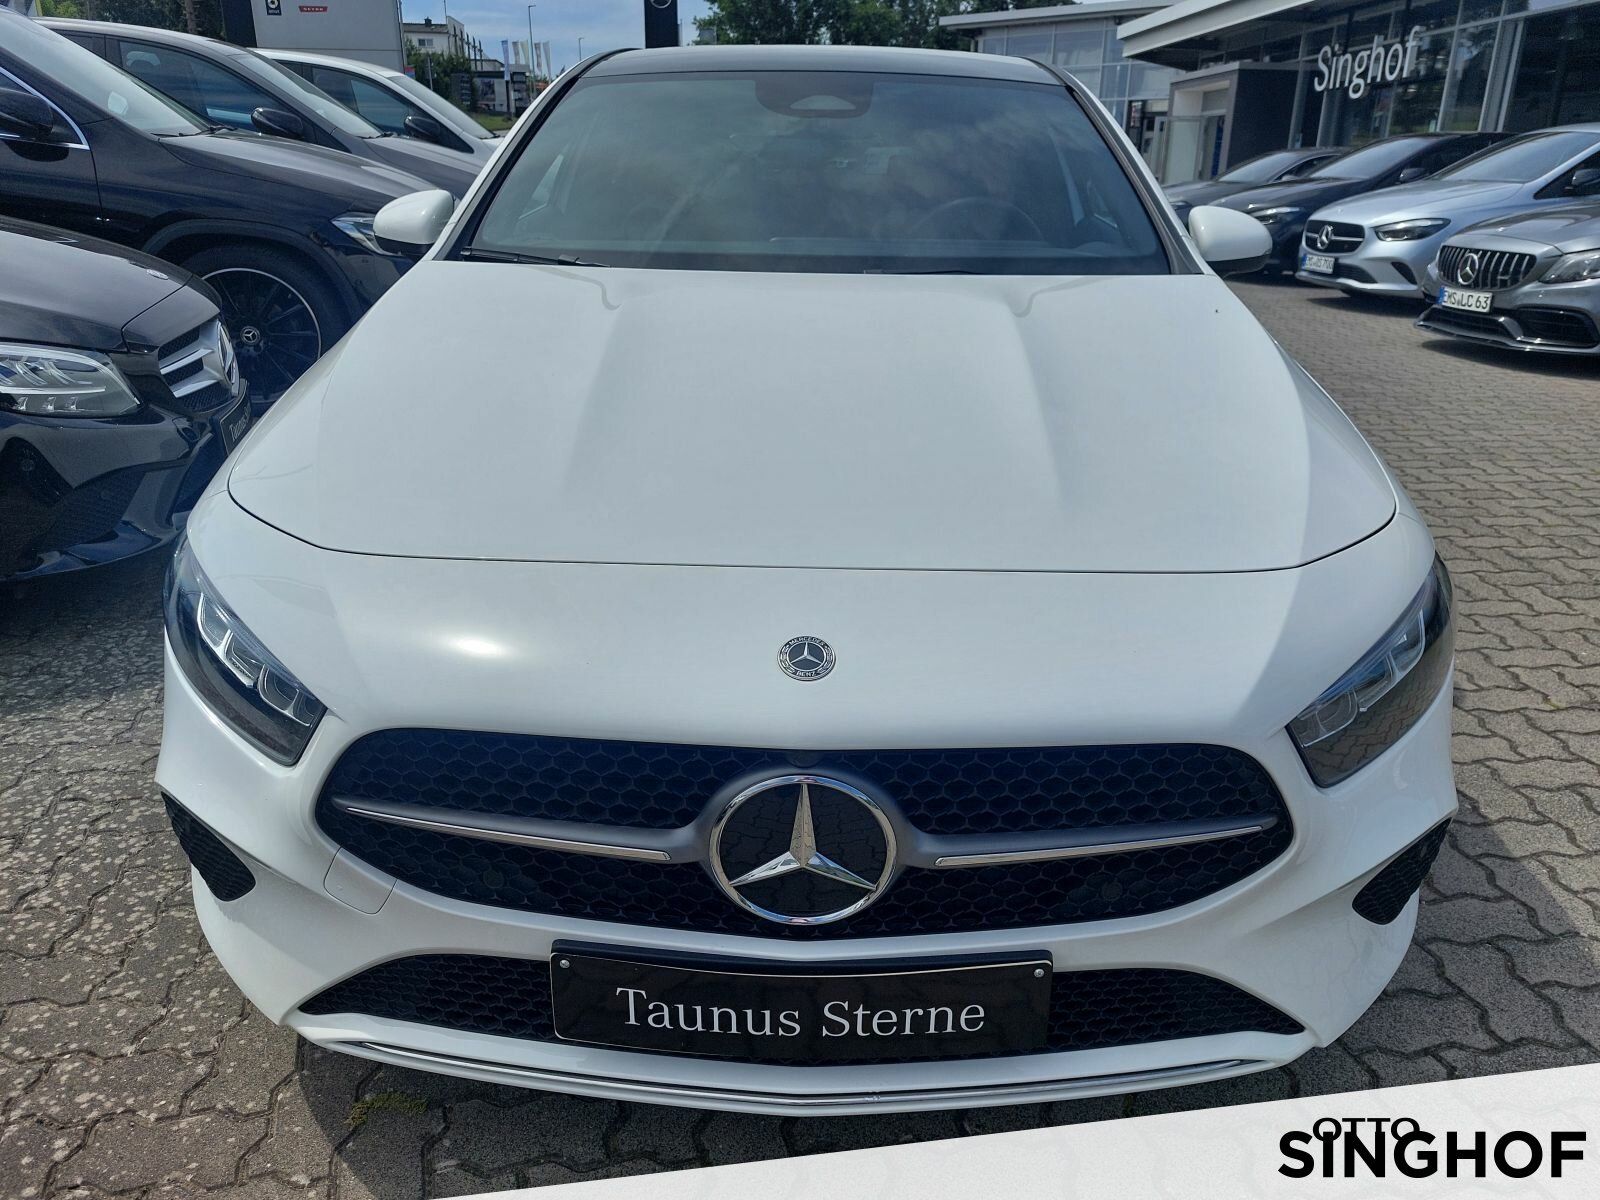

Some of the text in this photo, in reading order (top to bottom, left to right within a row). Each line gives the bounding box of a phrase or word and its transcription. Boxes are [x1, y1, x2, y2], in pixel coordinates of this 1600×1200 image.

[1314, 25, 1425, 99] Singhof
[1475, 295, 1490, 310] 63
[616, 987, 986, 1038] Taunus Sterne
